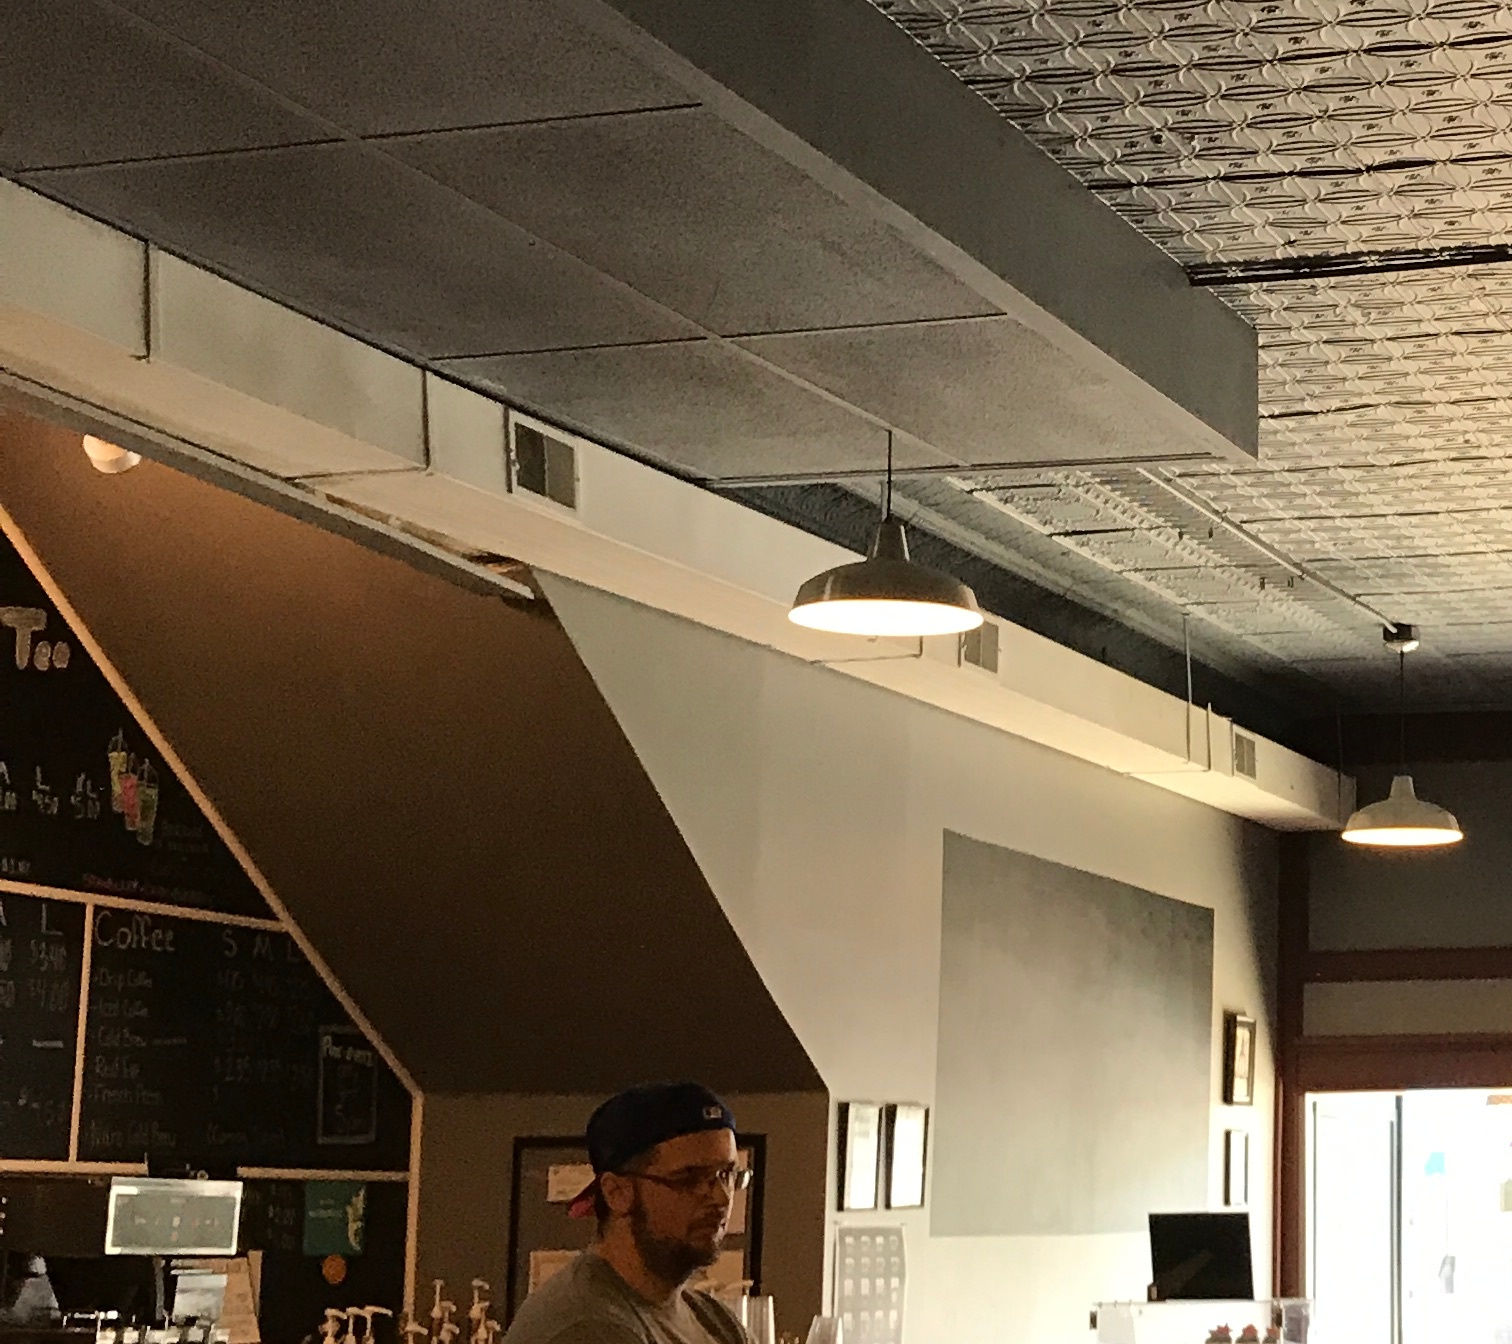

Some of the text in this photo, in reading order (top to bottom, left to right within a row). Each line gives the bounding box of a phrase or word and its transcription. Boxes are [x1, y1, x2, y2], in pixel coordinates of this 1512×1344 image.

[0, 605, 71, 672] Tea
[94, 909, 176, 953] Coffee
[222, 928, 238, 958] S
[252, 934, 274, 962] M
